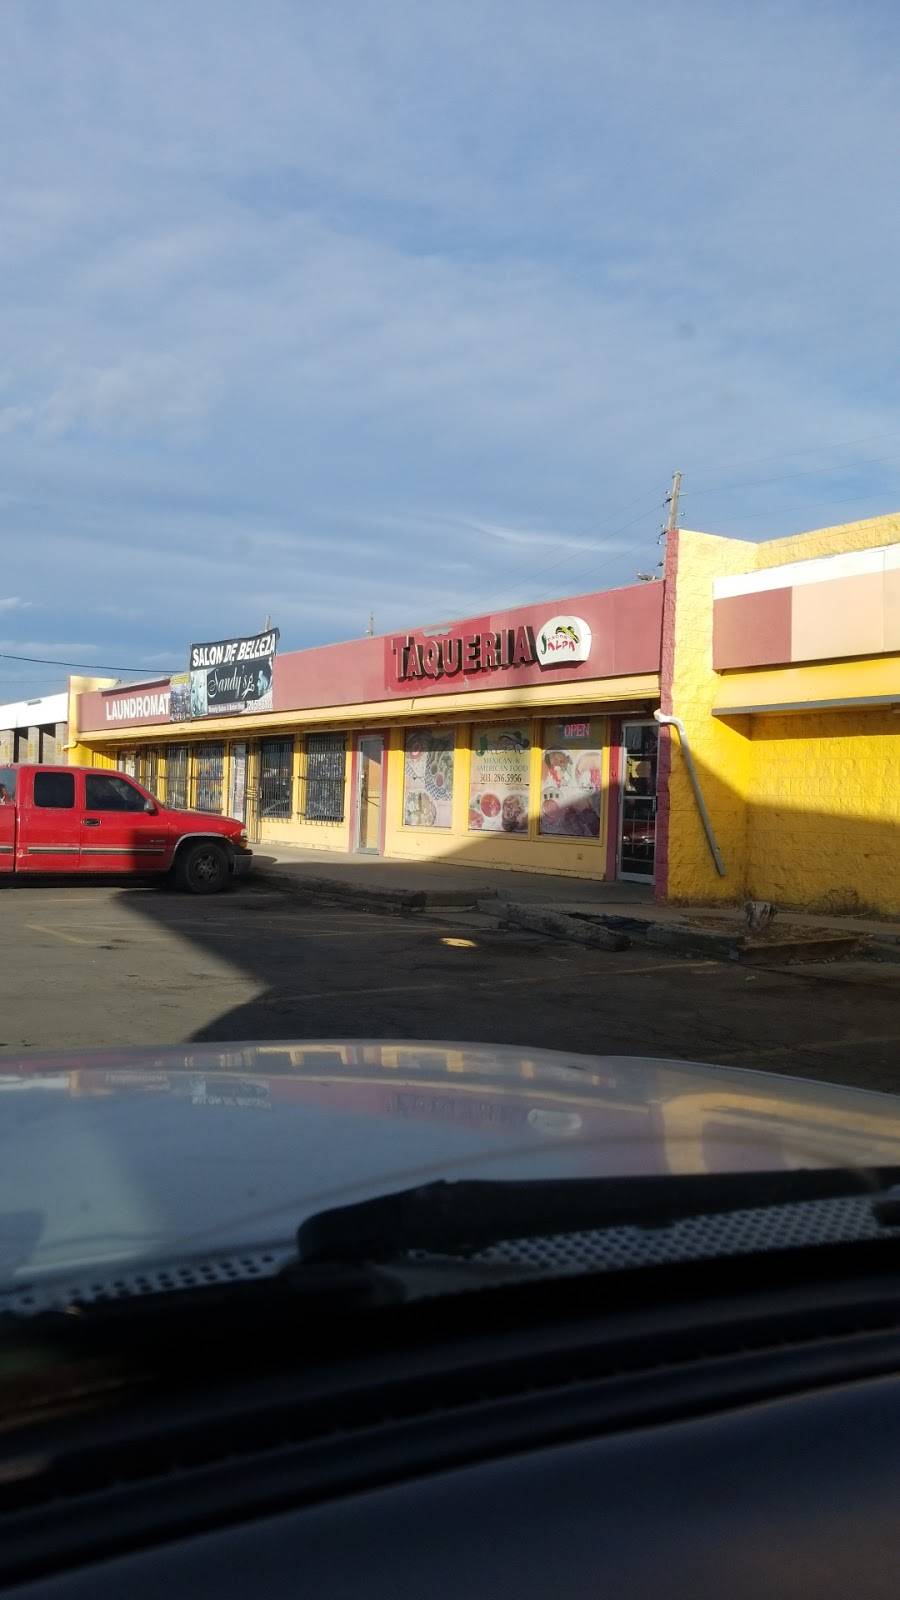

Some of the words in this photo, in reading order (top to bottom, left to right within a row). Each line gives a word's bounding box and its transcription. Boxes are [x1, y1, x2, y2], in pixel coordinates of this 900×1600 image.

[193, 646, 224, 667] SALON
[223, 643, 238, 663] DE
[237, 634, 276, 660] BELLEZA
[393, 626, 532, 679] TAQUERIA
[207, 665, 248, 698] Sandy's
[106, 693, 171, 720] LAUNDROMAT
[564, 723, 591, 737] OPEN
